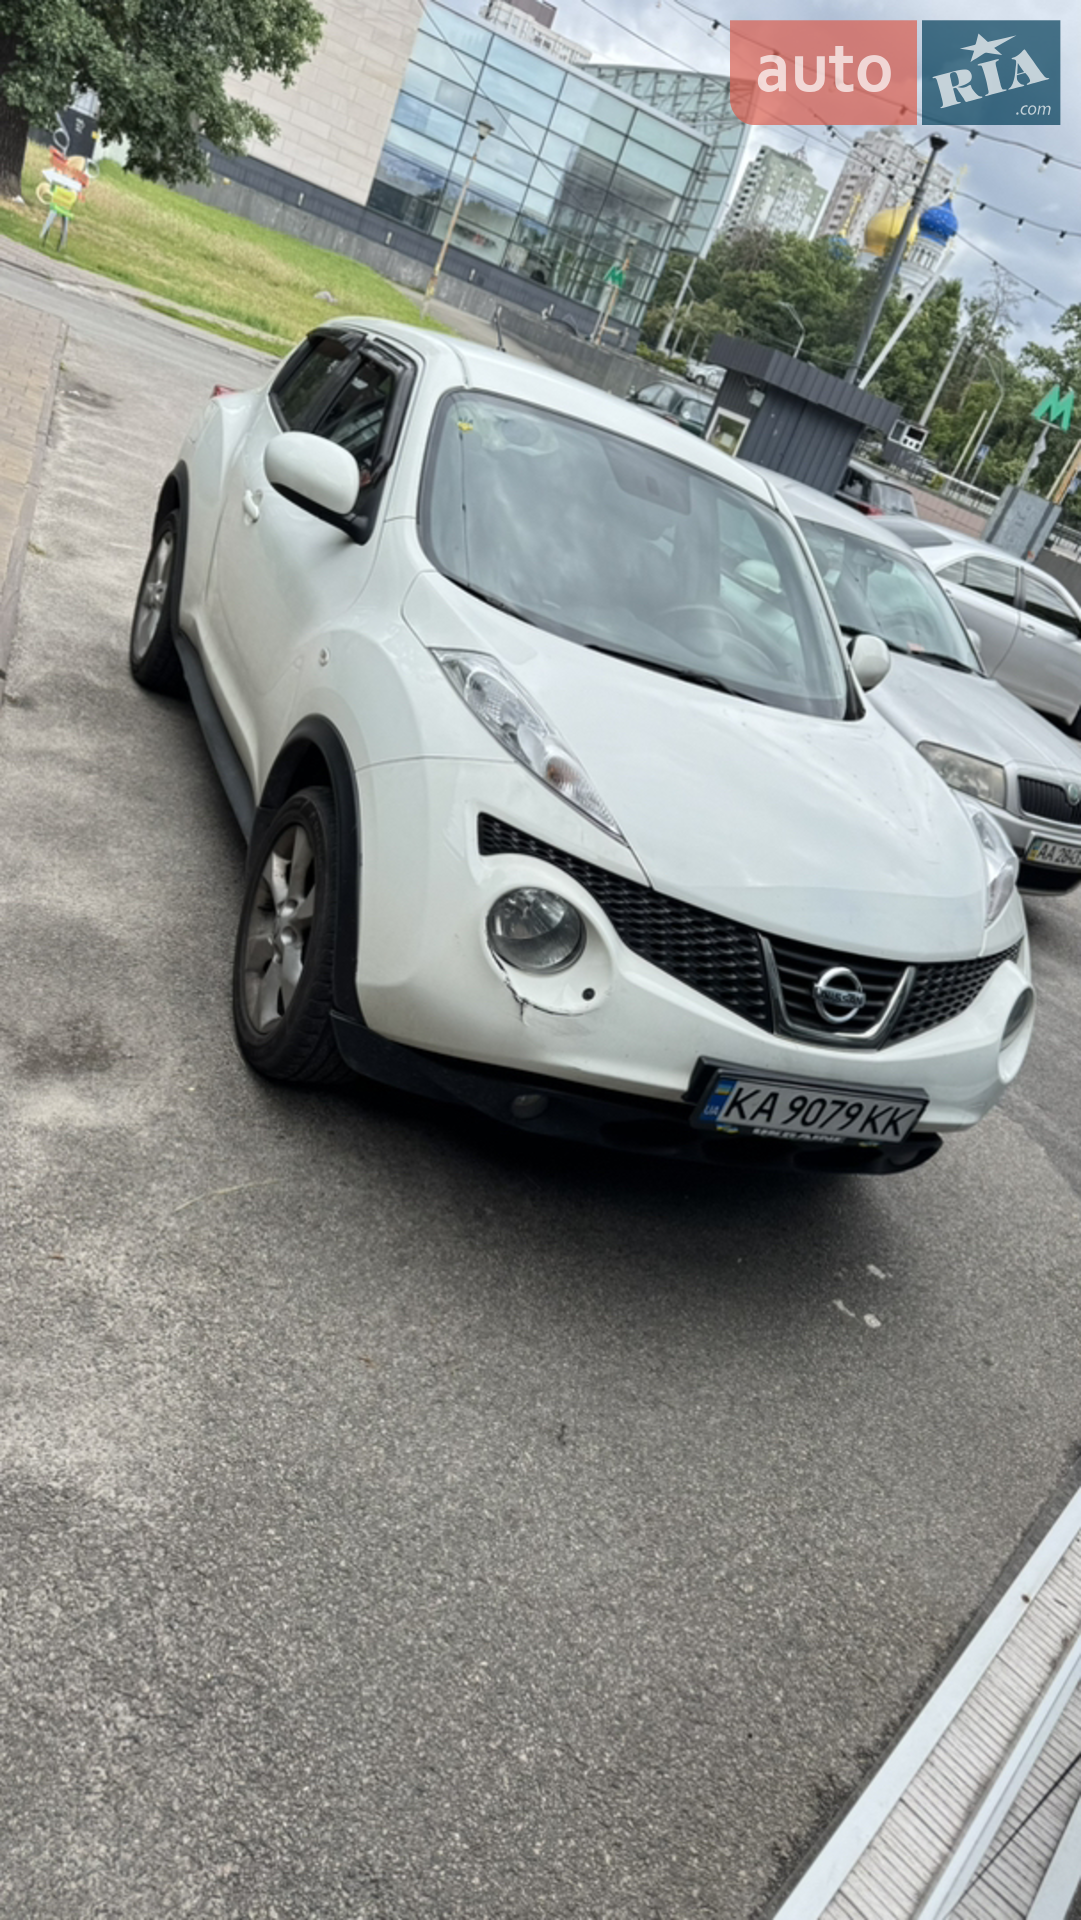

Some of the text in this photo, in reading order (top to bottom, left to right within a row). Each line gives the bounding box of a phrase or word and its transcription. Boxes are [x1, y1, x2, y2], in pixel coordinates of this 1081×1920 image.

[1031, 384, 1075, 432] M
[703, 1104, 719, 1116] UA
[723, 1087, 916, 1137] KA 9079 KK
